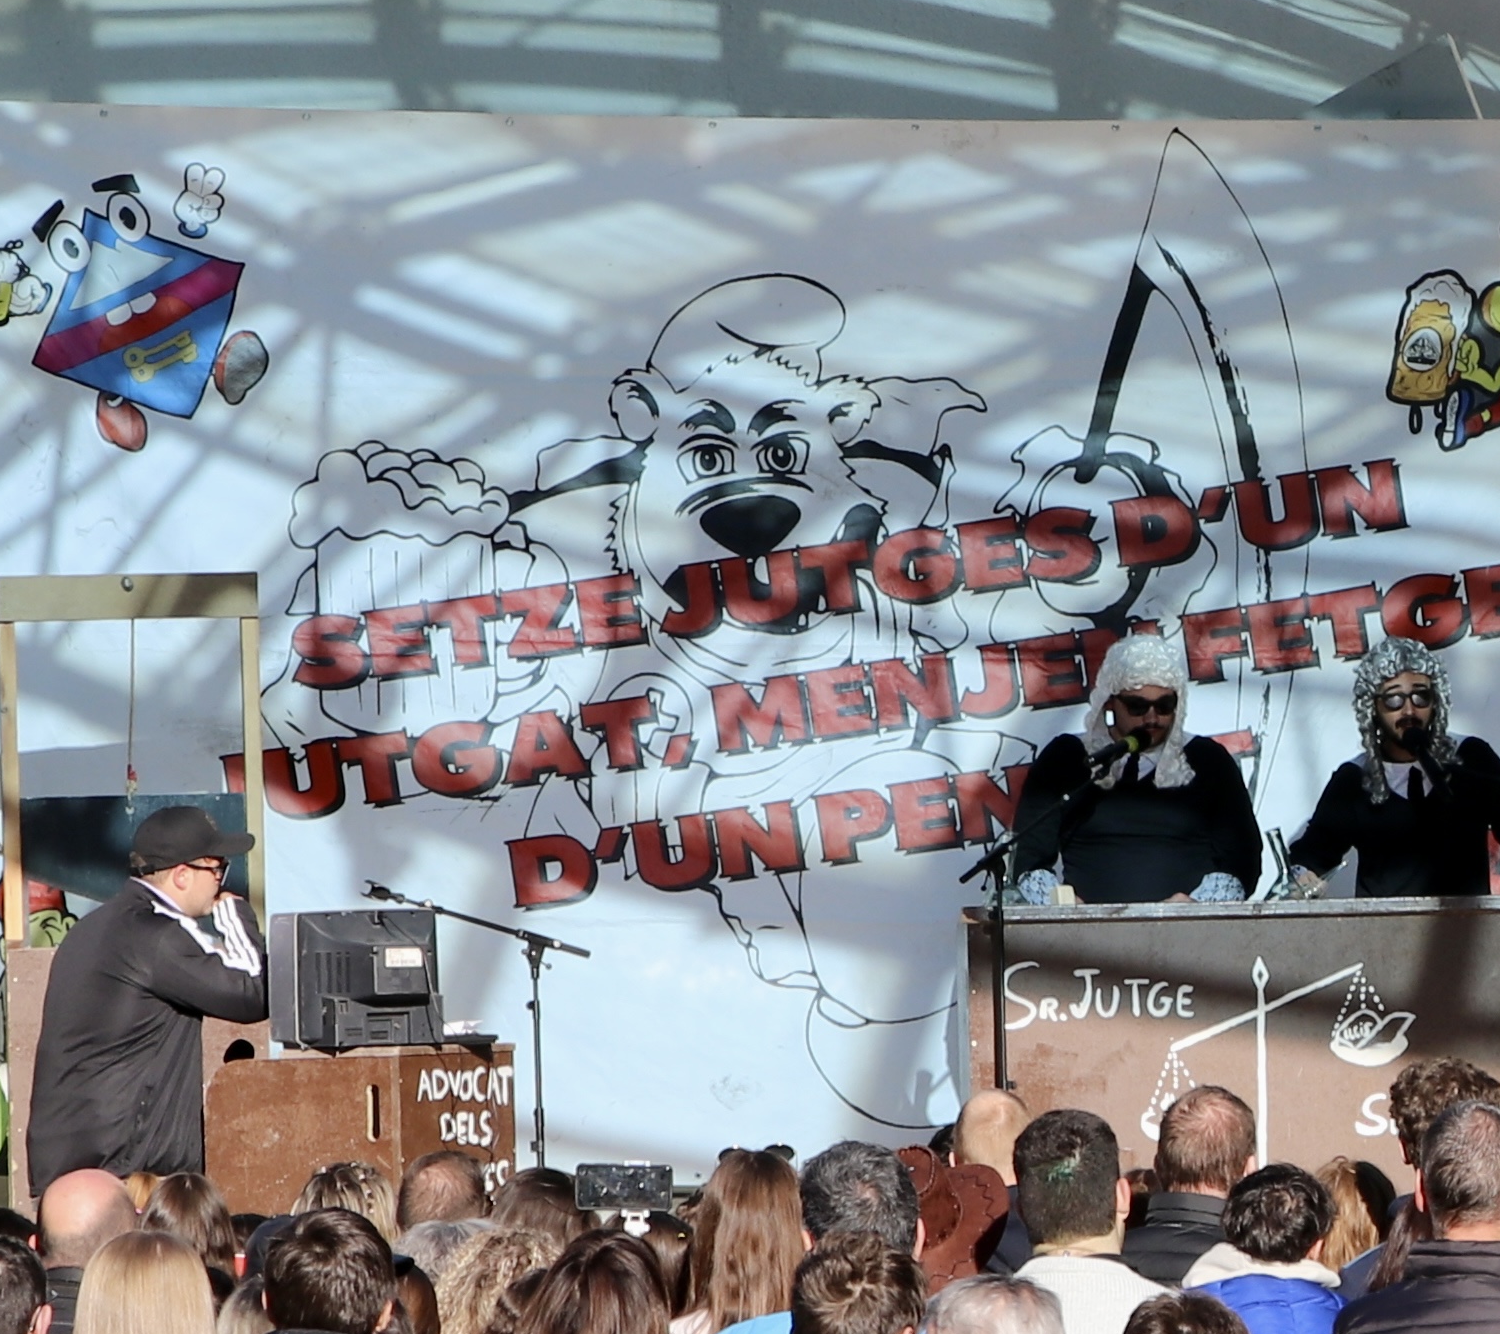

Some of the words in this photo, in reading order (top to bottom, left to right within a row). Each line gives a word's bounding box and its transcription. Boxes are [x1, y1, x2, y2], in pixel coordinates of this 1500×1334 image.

[290, 569, 650, 691] SETZE
[660, 506, 1103, 641] JUTGES
[1109, 459, 1412, 571] D'UN
[708, 617, 1168, 755] MENJE
[502, 799, 807, 912] D'UN
[416, 1066, 514, 1106] ADVOCAT
[439, 1110, 494, 1148] DELS
